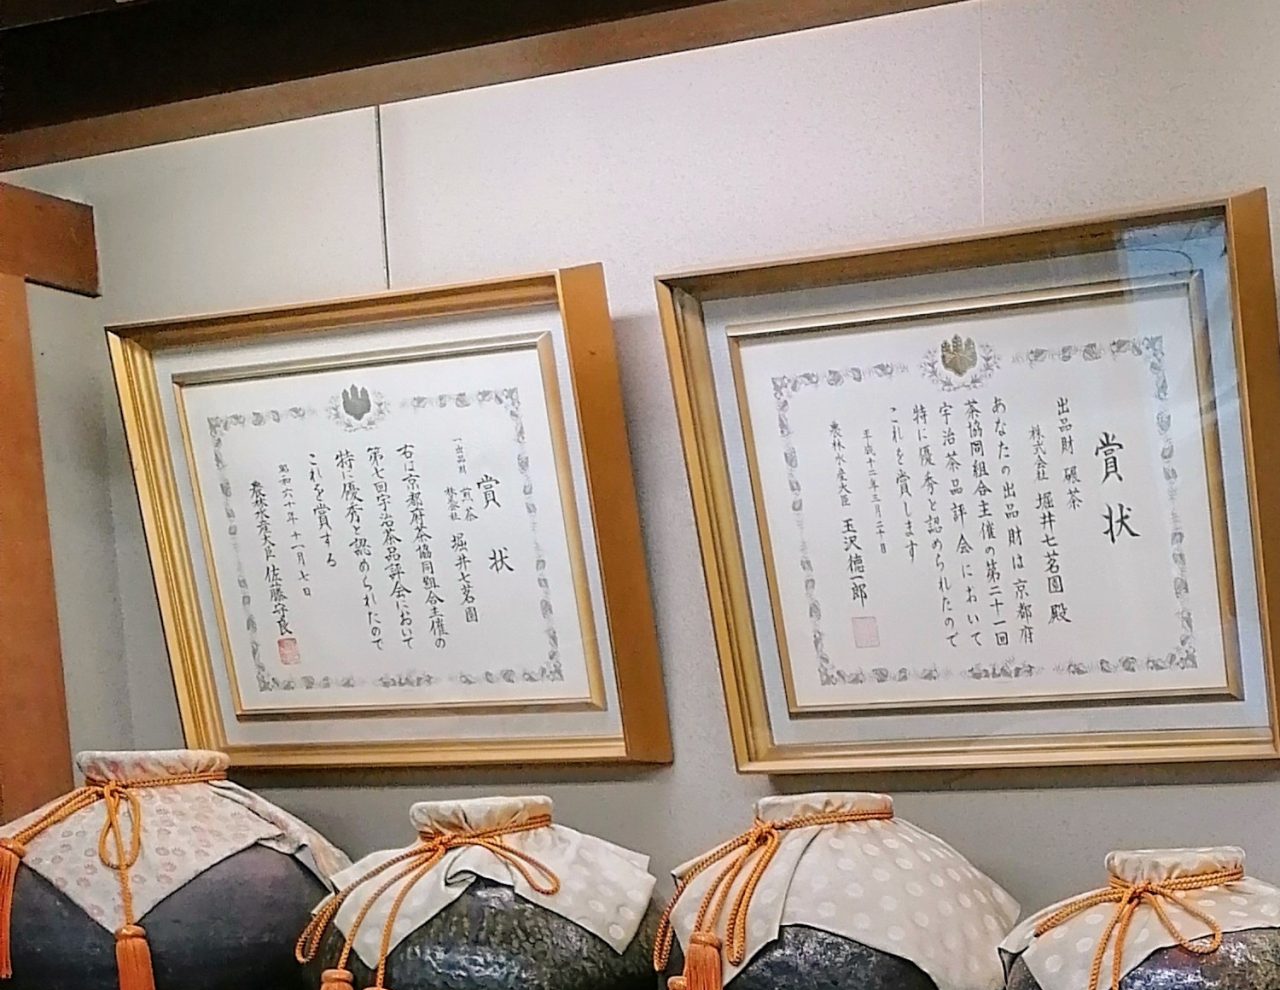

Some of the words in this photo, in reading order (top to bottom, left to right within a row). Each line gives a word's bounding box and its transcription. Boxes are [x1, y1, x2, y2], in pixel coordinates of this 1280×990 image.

[308, 452, 338, 568] これを賞する
[476, 474, 515, 573] 賞状
[890, 406, 919, 564] これを賞します
[912, 403, 959, 649] 特に優秀と認められたので
[938, 401, 984, 647] 宇治茶品評会において
[964, 398, 1009, 647] 茶協同組合主催の第二十一回
[991, 396, 1035, 645] あなたの出品財は京都府
[1056, 396, 1076, 456] 出品財
[1094, 431, 1142, 545] 賞状
[334, 448, 384, 651] 特に優秀と認められたので
[366, 446, 415, 650] 第七回宇治茶品評会において
